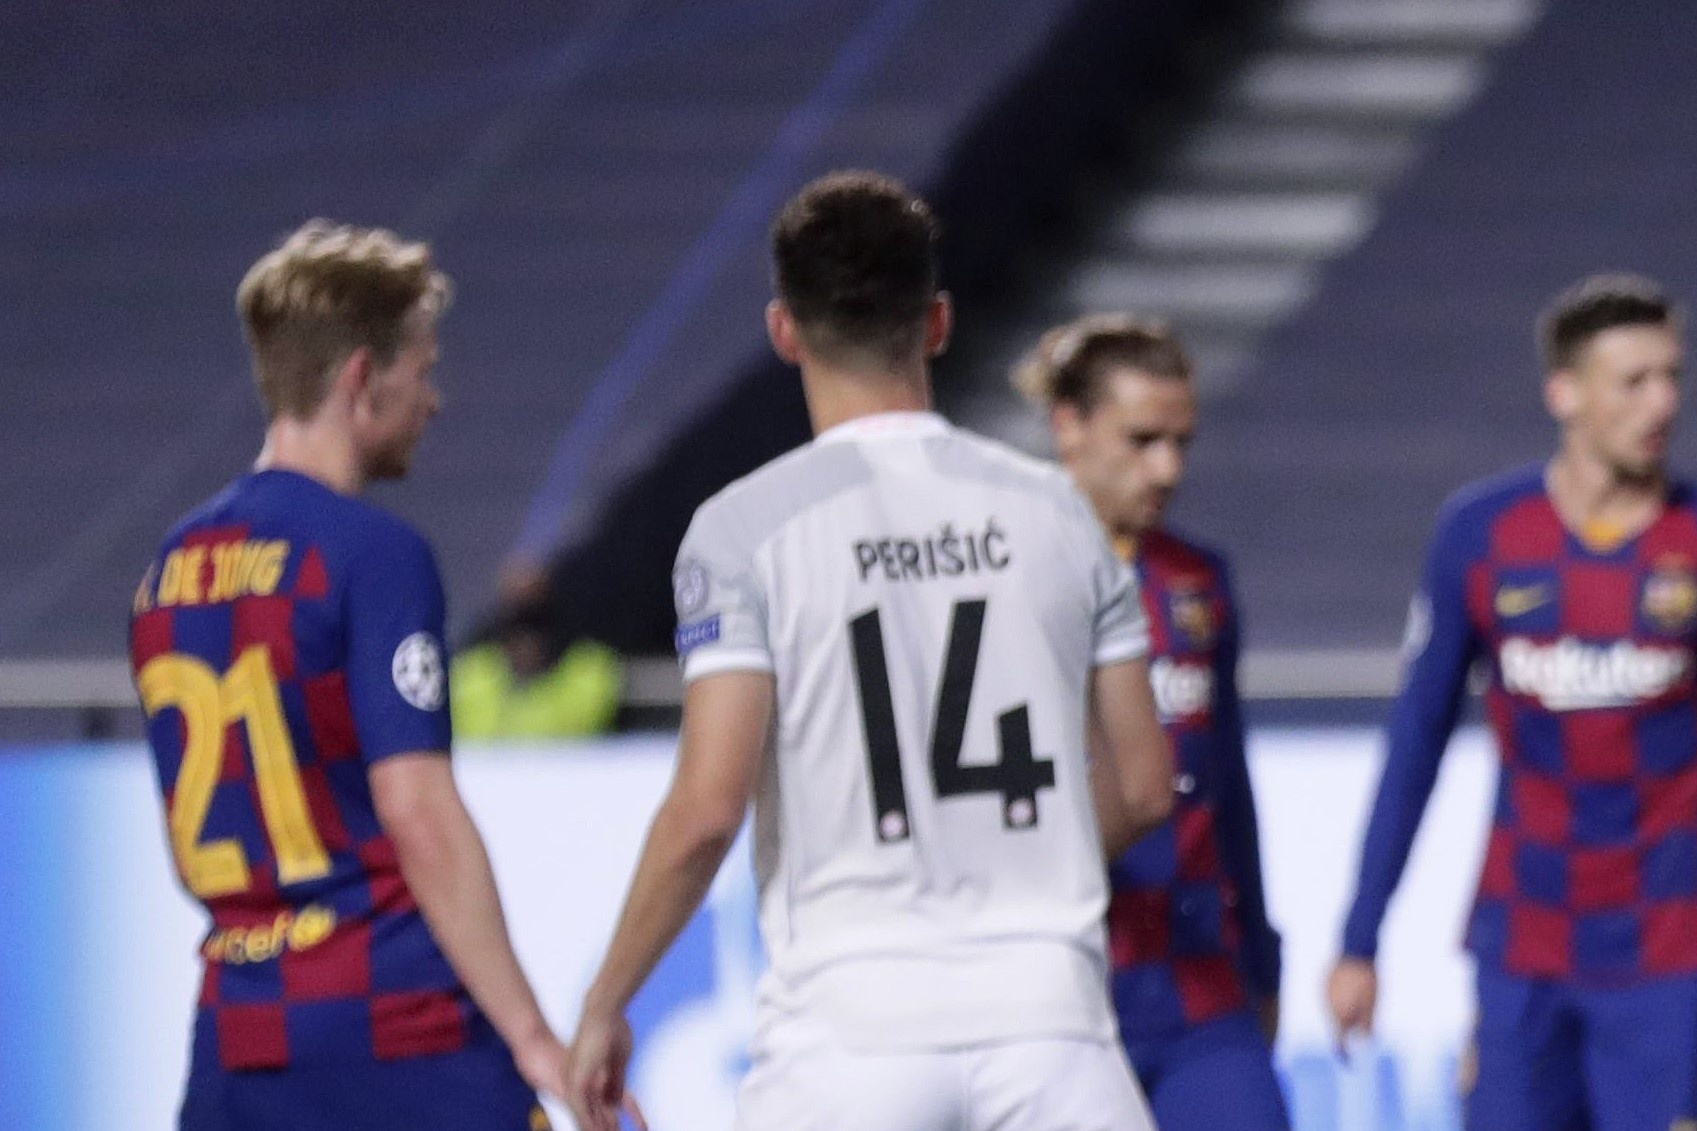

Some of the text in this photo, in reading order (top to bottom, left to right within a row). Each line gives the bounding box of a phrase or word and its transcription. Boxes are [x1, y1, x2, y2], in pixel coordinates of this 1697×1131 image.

[158, 544, 206, 608] DE
[852, 515, 1011, 584] PERIŠIĆ
[137, 643, 332, 898] 21
[848, 598, 1056, 844] 14
